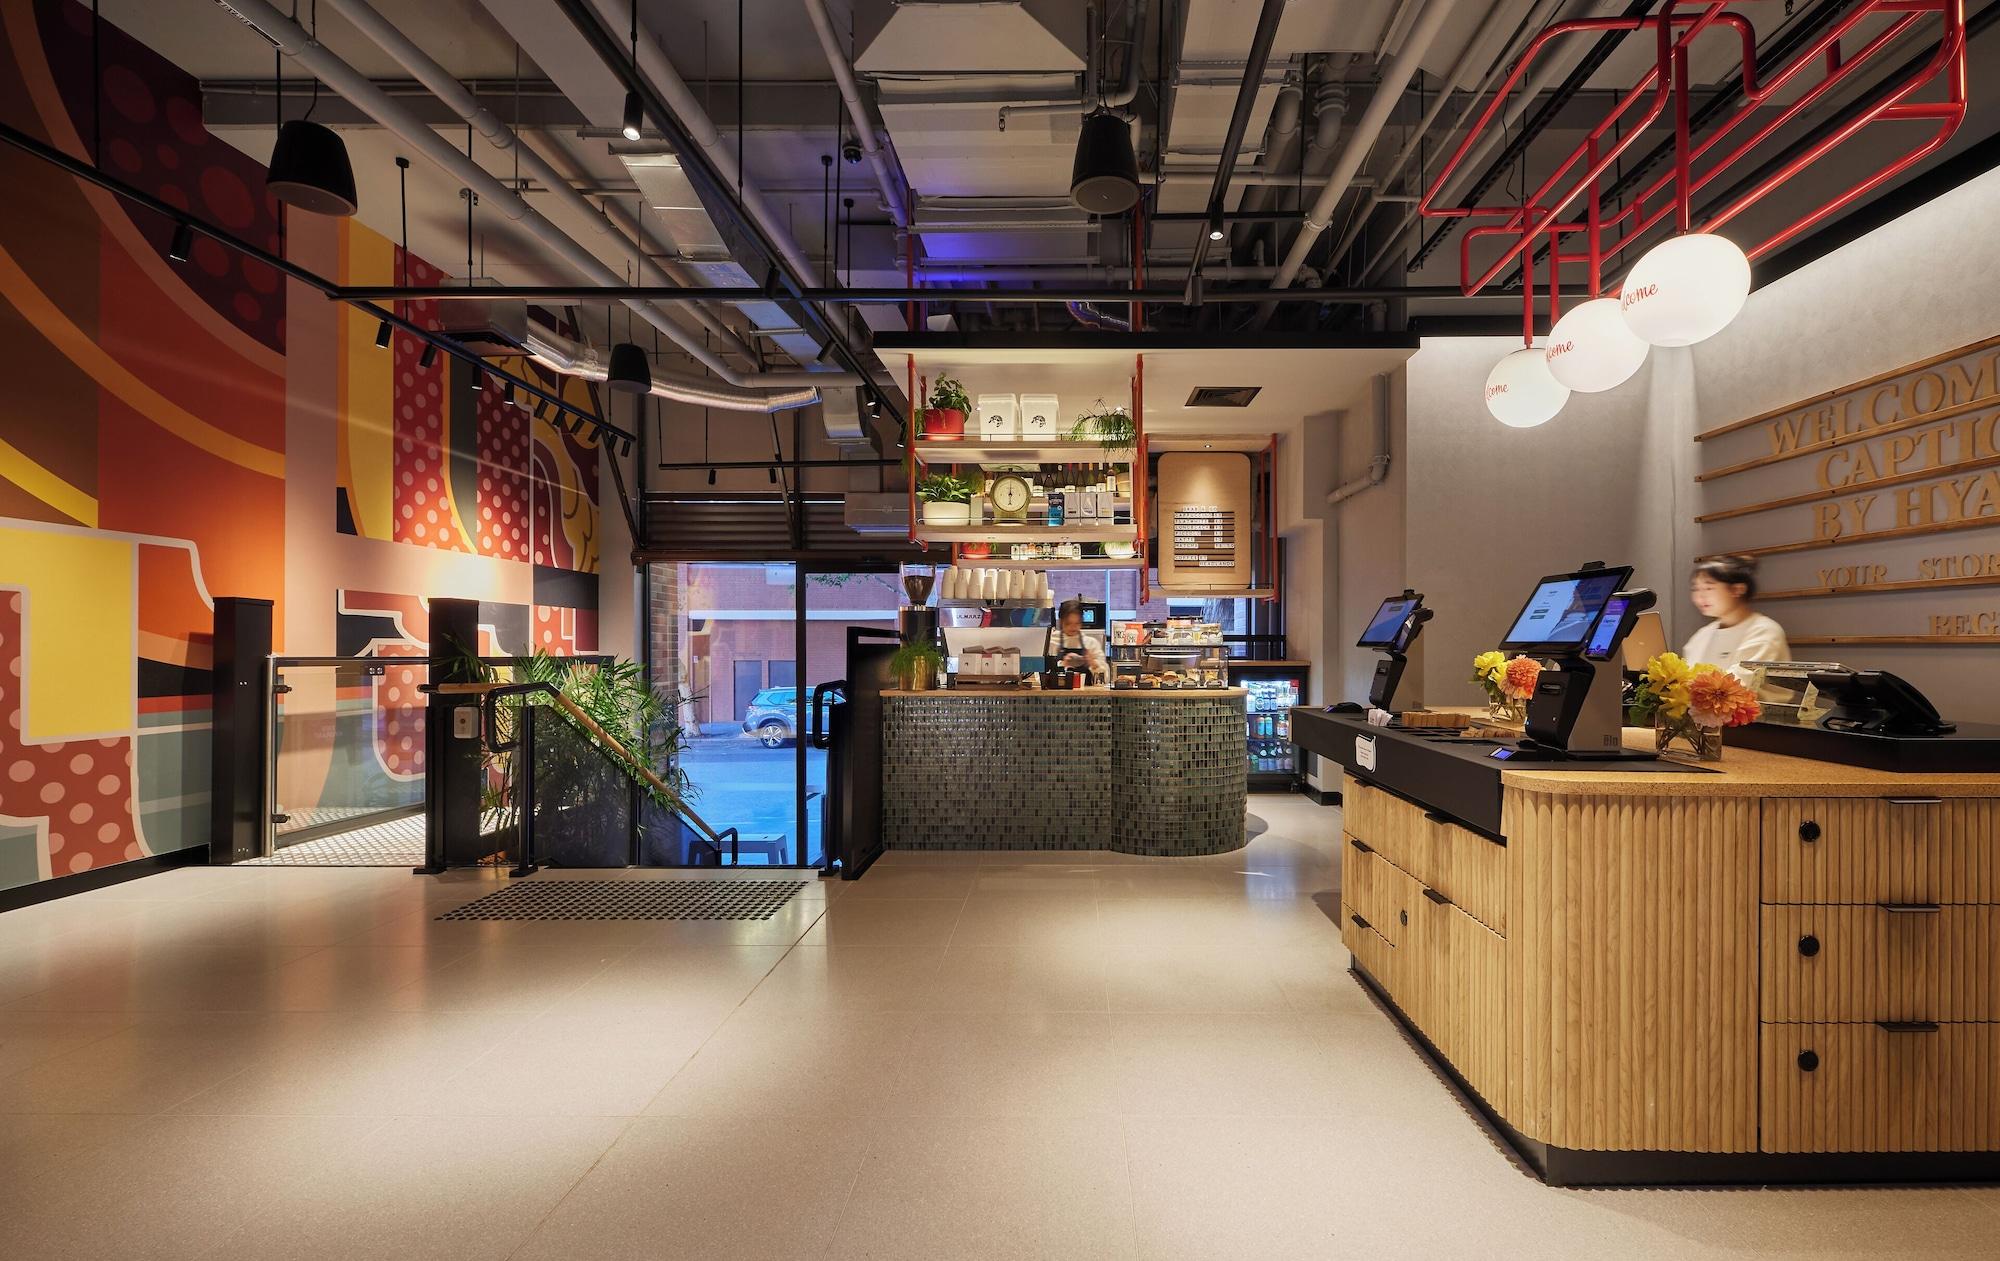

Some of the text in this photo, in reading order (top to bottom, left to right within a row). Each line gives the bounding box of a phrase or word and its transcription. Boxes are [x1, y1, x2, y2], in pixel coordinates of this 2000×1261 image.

[1765, 352, 2000, 457] WELCOM
[1812, 471, 2000, 541] BY HYA
[1816, 552, 2000, 587] YOUR STOR
